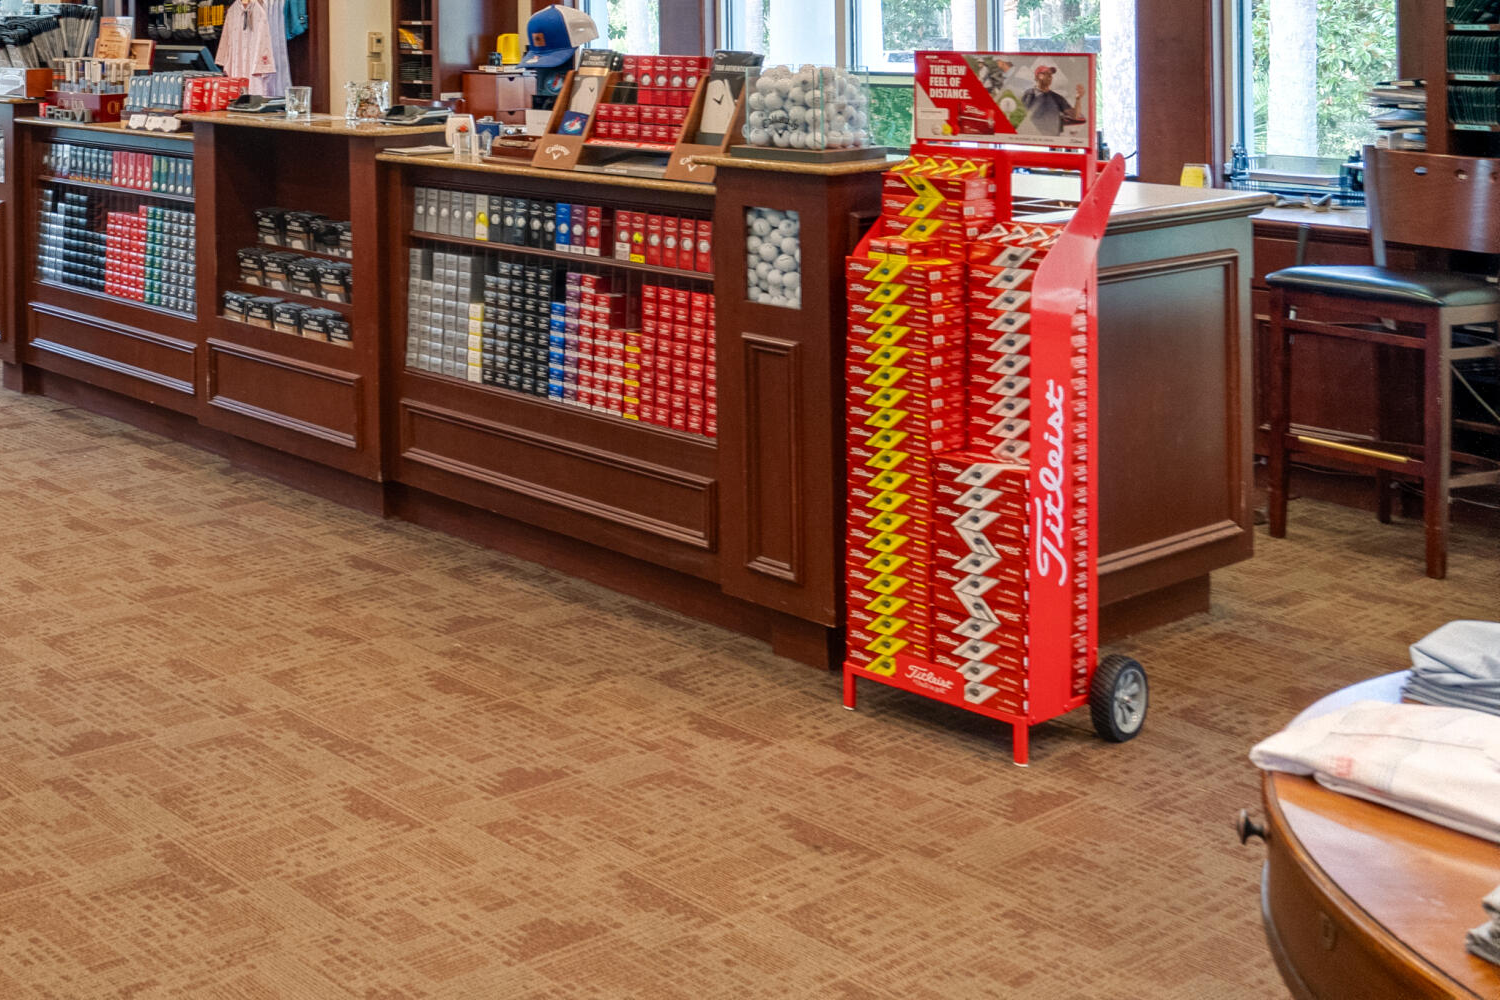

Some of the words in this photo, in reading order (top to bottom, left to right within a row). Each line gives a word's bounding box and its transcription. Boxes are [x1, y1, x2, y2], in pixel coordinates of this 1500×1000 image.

[929, 64, 946, 76] THE
[946, 65, 967, 76] NEW
[929, 76, 948, 87] FEEL
[949, 77, 962, 87] OF
[929, 88, 972, 100] DISTANCE.
[1035, 379, 1068, 587] Titleist
[904, 664, 955, 690] Titleist
